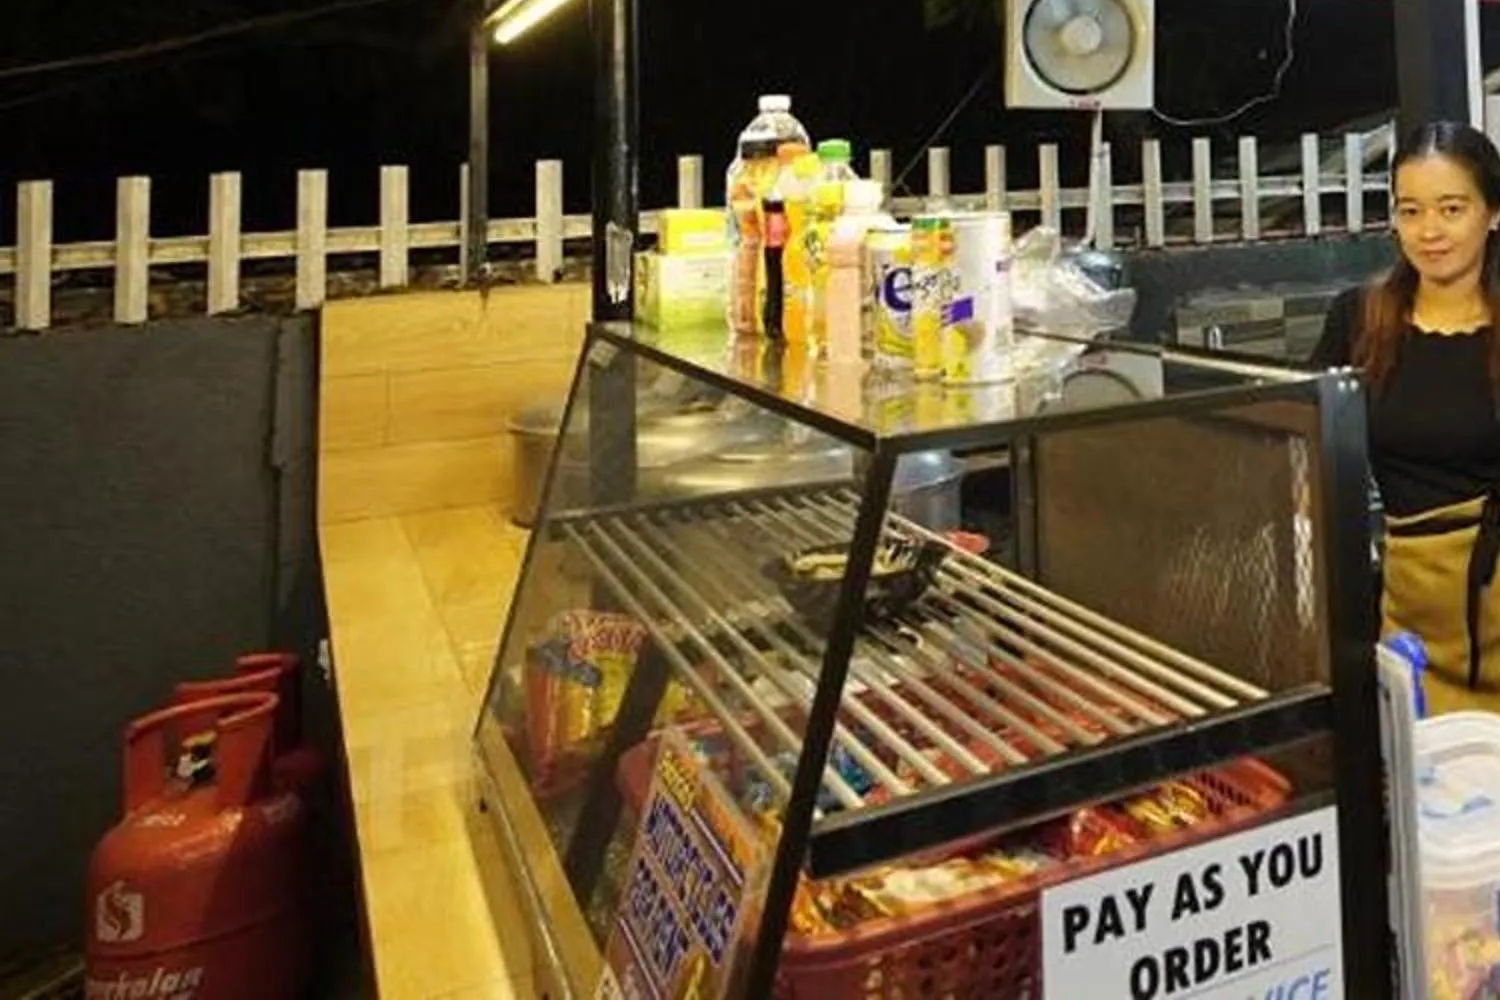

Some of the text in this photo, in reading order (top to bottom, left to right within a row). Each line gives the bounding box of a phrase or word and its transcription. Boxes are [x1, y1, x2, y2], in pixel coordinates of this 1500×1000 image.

[1062, 833, 1323, 953] PAY AS YOU
[1129, 920, 1273, 1000] ORDER
